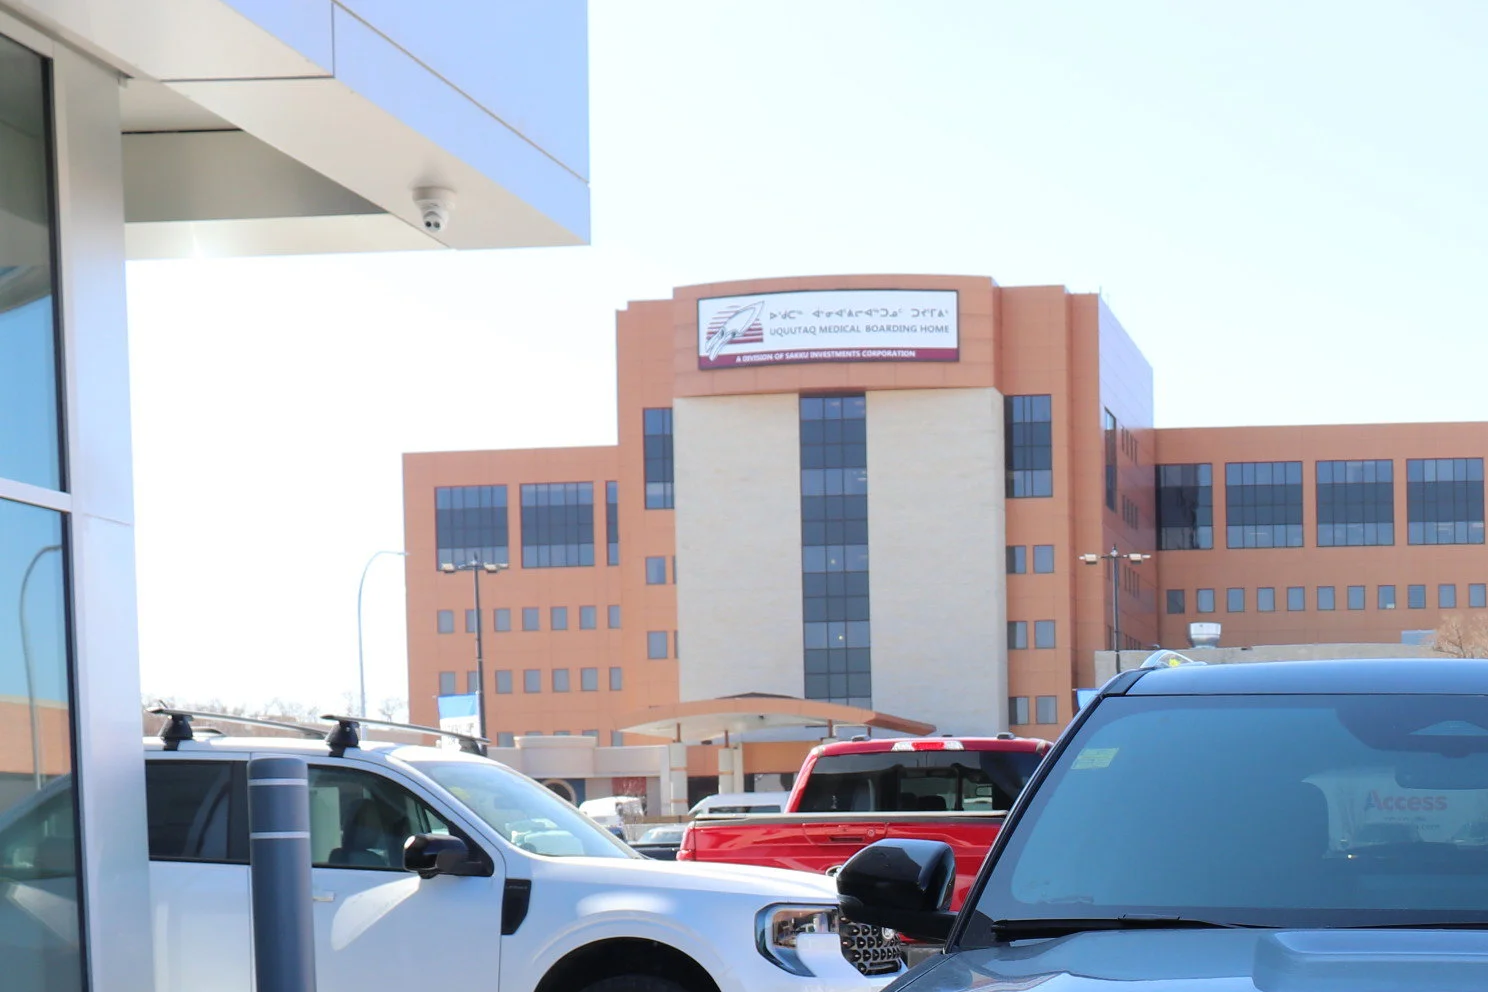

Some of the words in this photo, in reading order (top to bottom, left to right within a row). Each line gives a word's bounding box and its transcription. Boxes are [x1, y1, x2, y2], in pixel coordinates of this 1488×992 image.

[769, 325, 817, 338] UQUUTAQ
[819, 325, 861, 334] MEDICAL
[865, 324, 917, 333] BOARDING
[920, 325, 950, 333] HOME
[735, 355, 741, 363] A
[742, 353, 773, 362] DIVISION
[774, 352, 785, 360] OF
[810, 350, 860, 359] INVESTMENTS
[861, 349, 916, 358] CORPORATION
[1364, 789, 1448, 811] Access
